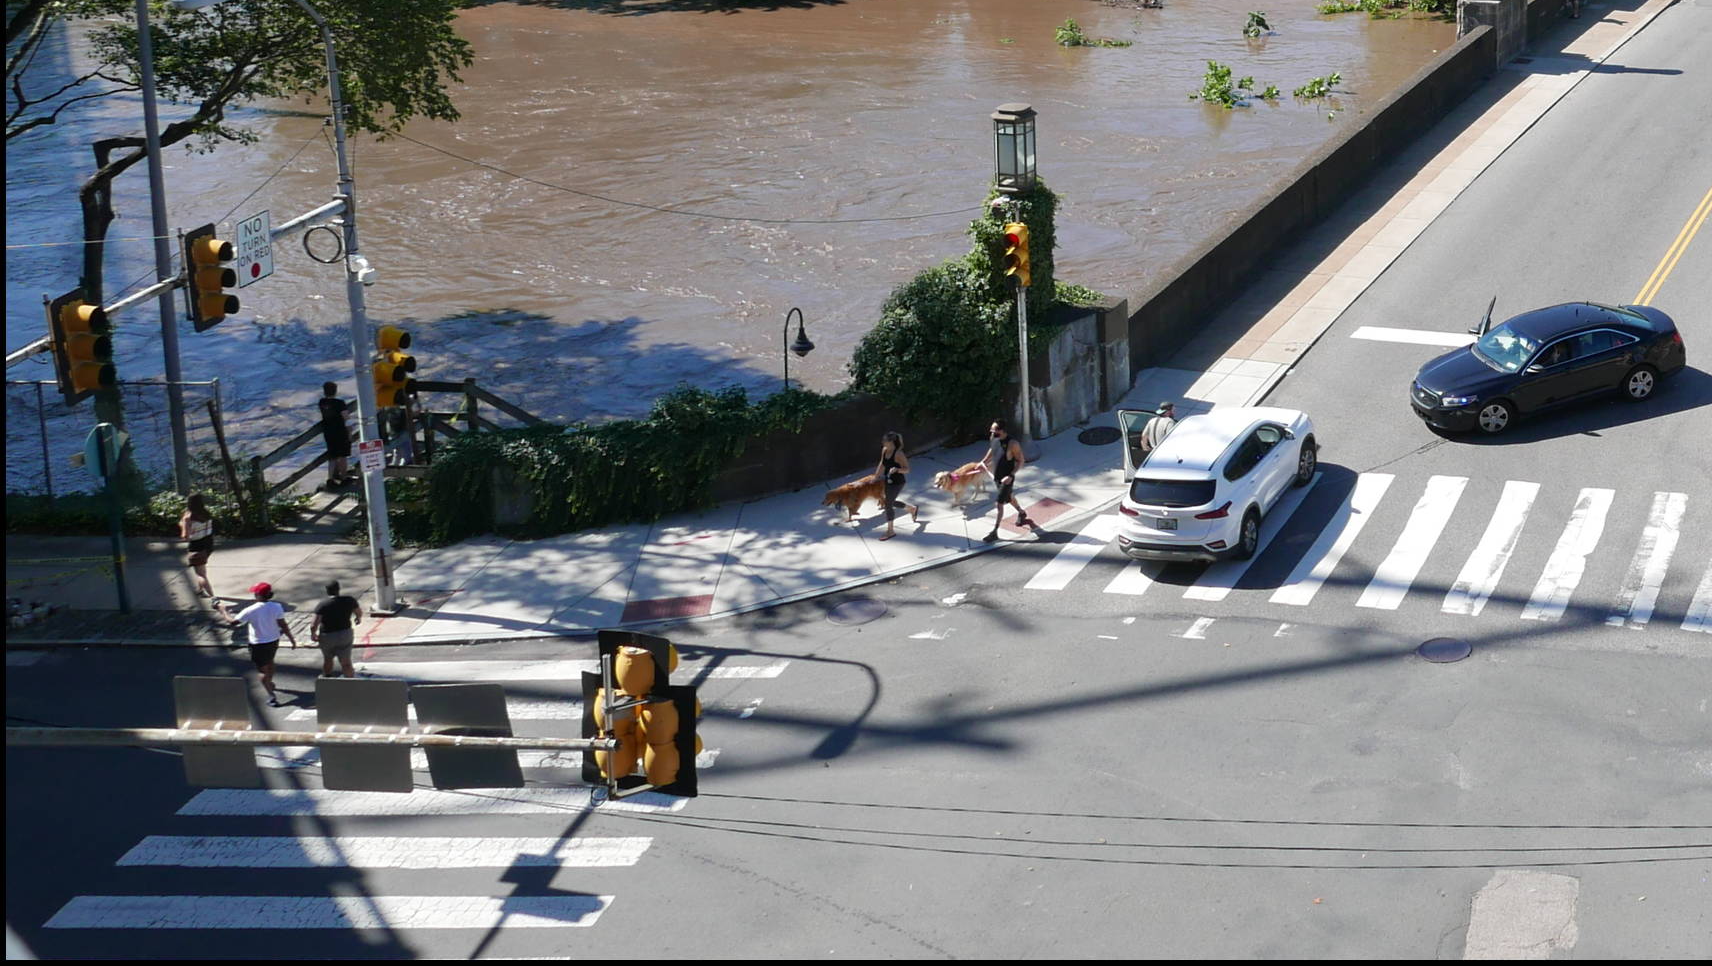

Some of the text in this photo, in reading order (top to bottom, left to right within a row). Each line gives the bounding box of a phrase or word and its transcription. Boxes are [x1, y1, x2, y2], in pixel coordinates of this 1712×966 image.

[244, 218, 262, 237] NO
[242, 235, 266, 251] TURN
[240, 245, 270, 267] ON RED
